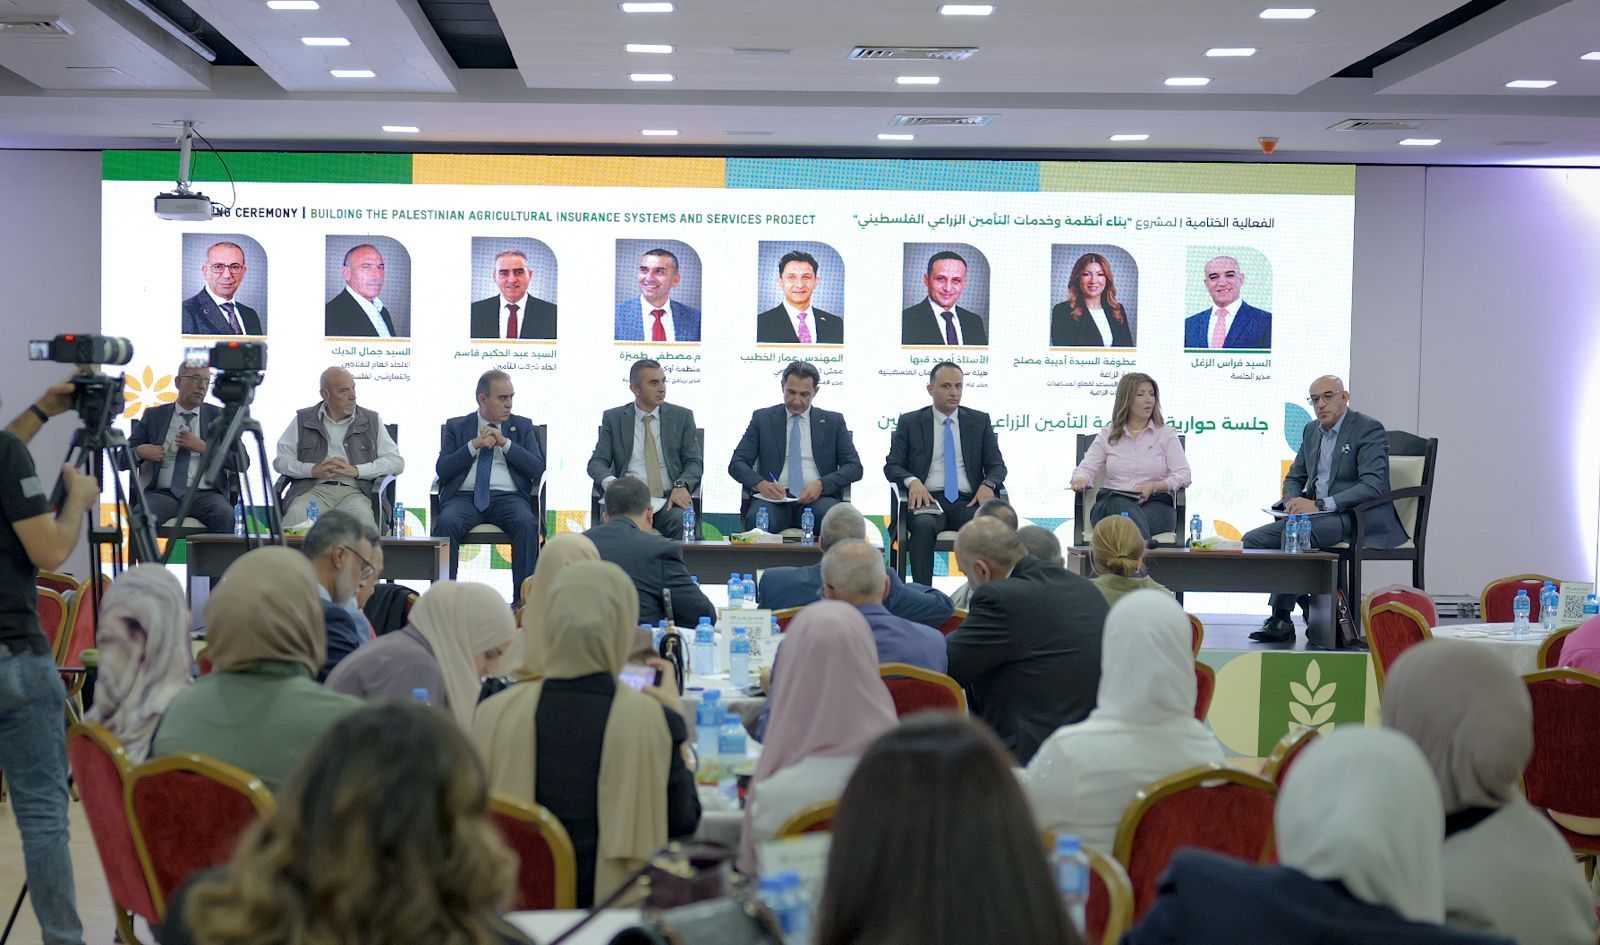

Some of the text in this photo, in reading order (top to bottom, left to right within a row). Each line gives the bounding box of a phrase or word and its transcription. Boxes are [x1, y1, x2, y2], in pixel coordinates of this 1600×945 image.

[235, 207, 298, 219] CEREMONY
[311, 208, 363, 220] BUILDING
[366, 209, 388, 220] THE
[391, 209, 465, 221] PALESTINIAN
[468, 210, 553, 222] AGRICULTURAL
[556, 212, 620, 223] INSURANCE
[624, 212, 676, 224] SYSTEMS
[679, 213, 703, 224] AND
[706, 213, 762, 225] SERVICES
[766, 214, 816, 225] PROJECT
[927, 213, 966, 231] الزراعي
[969, 212, 1010, 228] التأمين
[1013, 214, 1061, 229] وخدمات
[1064, 213, 1102, 226] أنظمة
[1185, 216, 1229, 230] الختامية
[1231, 216, 1275, 230] الفعالية
[1135, 216, 1177, 231] لمشروع
[331, 346, 411, 358] السيد جمال الديك
[453, 348, 557, 360] السيد عبد الحكيم قاسم
[740, 352, 844, 364] المهندس عمار الخطيب
[955, 353, 989, 364] الأستاذ
[909, 354, 930, 366] قبها
[1012, 355, 1137, 368] عطوفة السيدة أديبة مصلح
[1191, 358, 1272, 370] السيد فراس الزغل
[1034, 411, 1088, 432] التأمين
[1166, 415, 1216, 434] حوارية
[1221, 416, 1269, 436] جلسة
